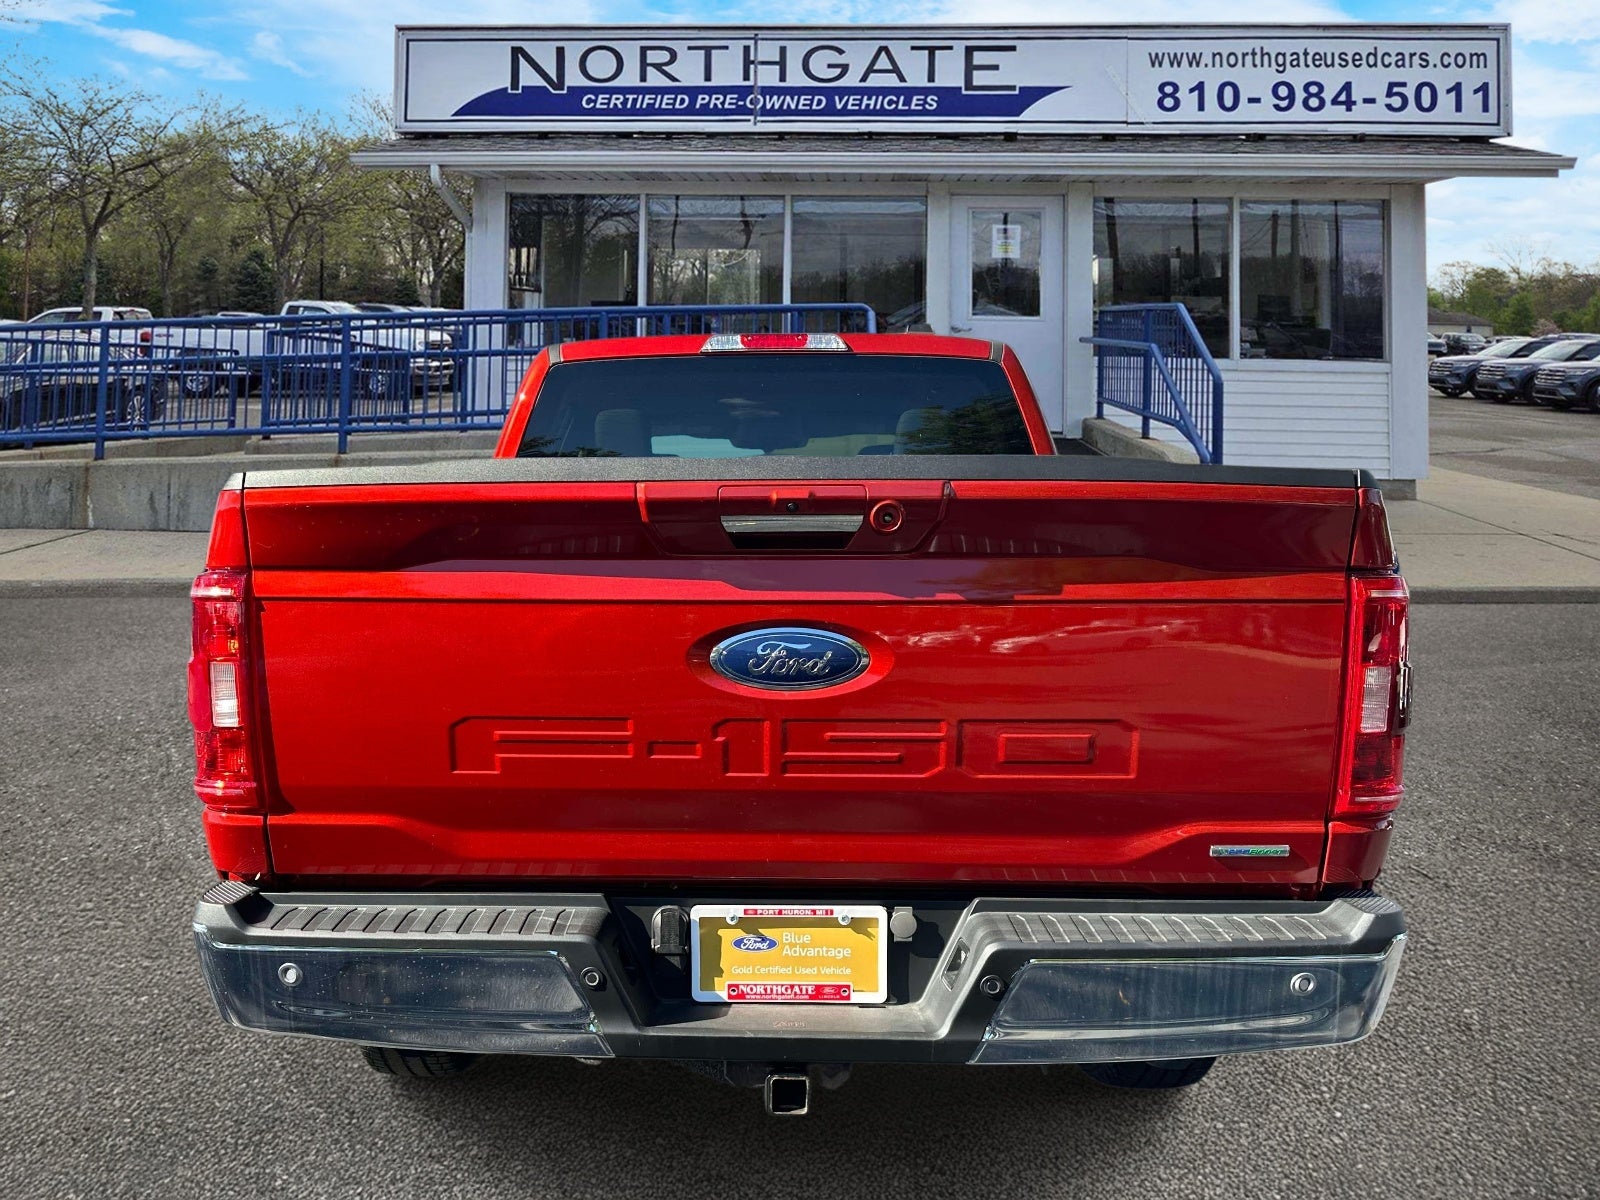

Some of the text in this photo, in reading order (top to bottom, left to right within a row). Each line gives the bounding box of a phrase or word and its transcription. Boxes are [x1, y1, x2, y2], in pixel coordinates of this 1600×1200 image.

[510, 45, 1018, 93] NORTHGATE
[1148, 47, 1488, 74] www.northgateusedcars.com
[581, 94, 939, 112] CERTIFIED PRE-OWNED VEHICLES
[1156, 80, 1490, 113] 810-984-5011
[748, 640, 833, 676] Ford
[449, 716, 1139, 778] F-150
[740, 937, 769, 950] Ford
[782, 932, 811, 943] Blue
[782, 946, 851, 960] Advantage
[731, 966, 852, 975] Gold Certified Used Vehicle
[738, 985, 816, 994] NORTHGATE
